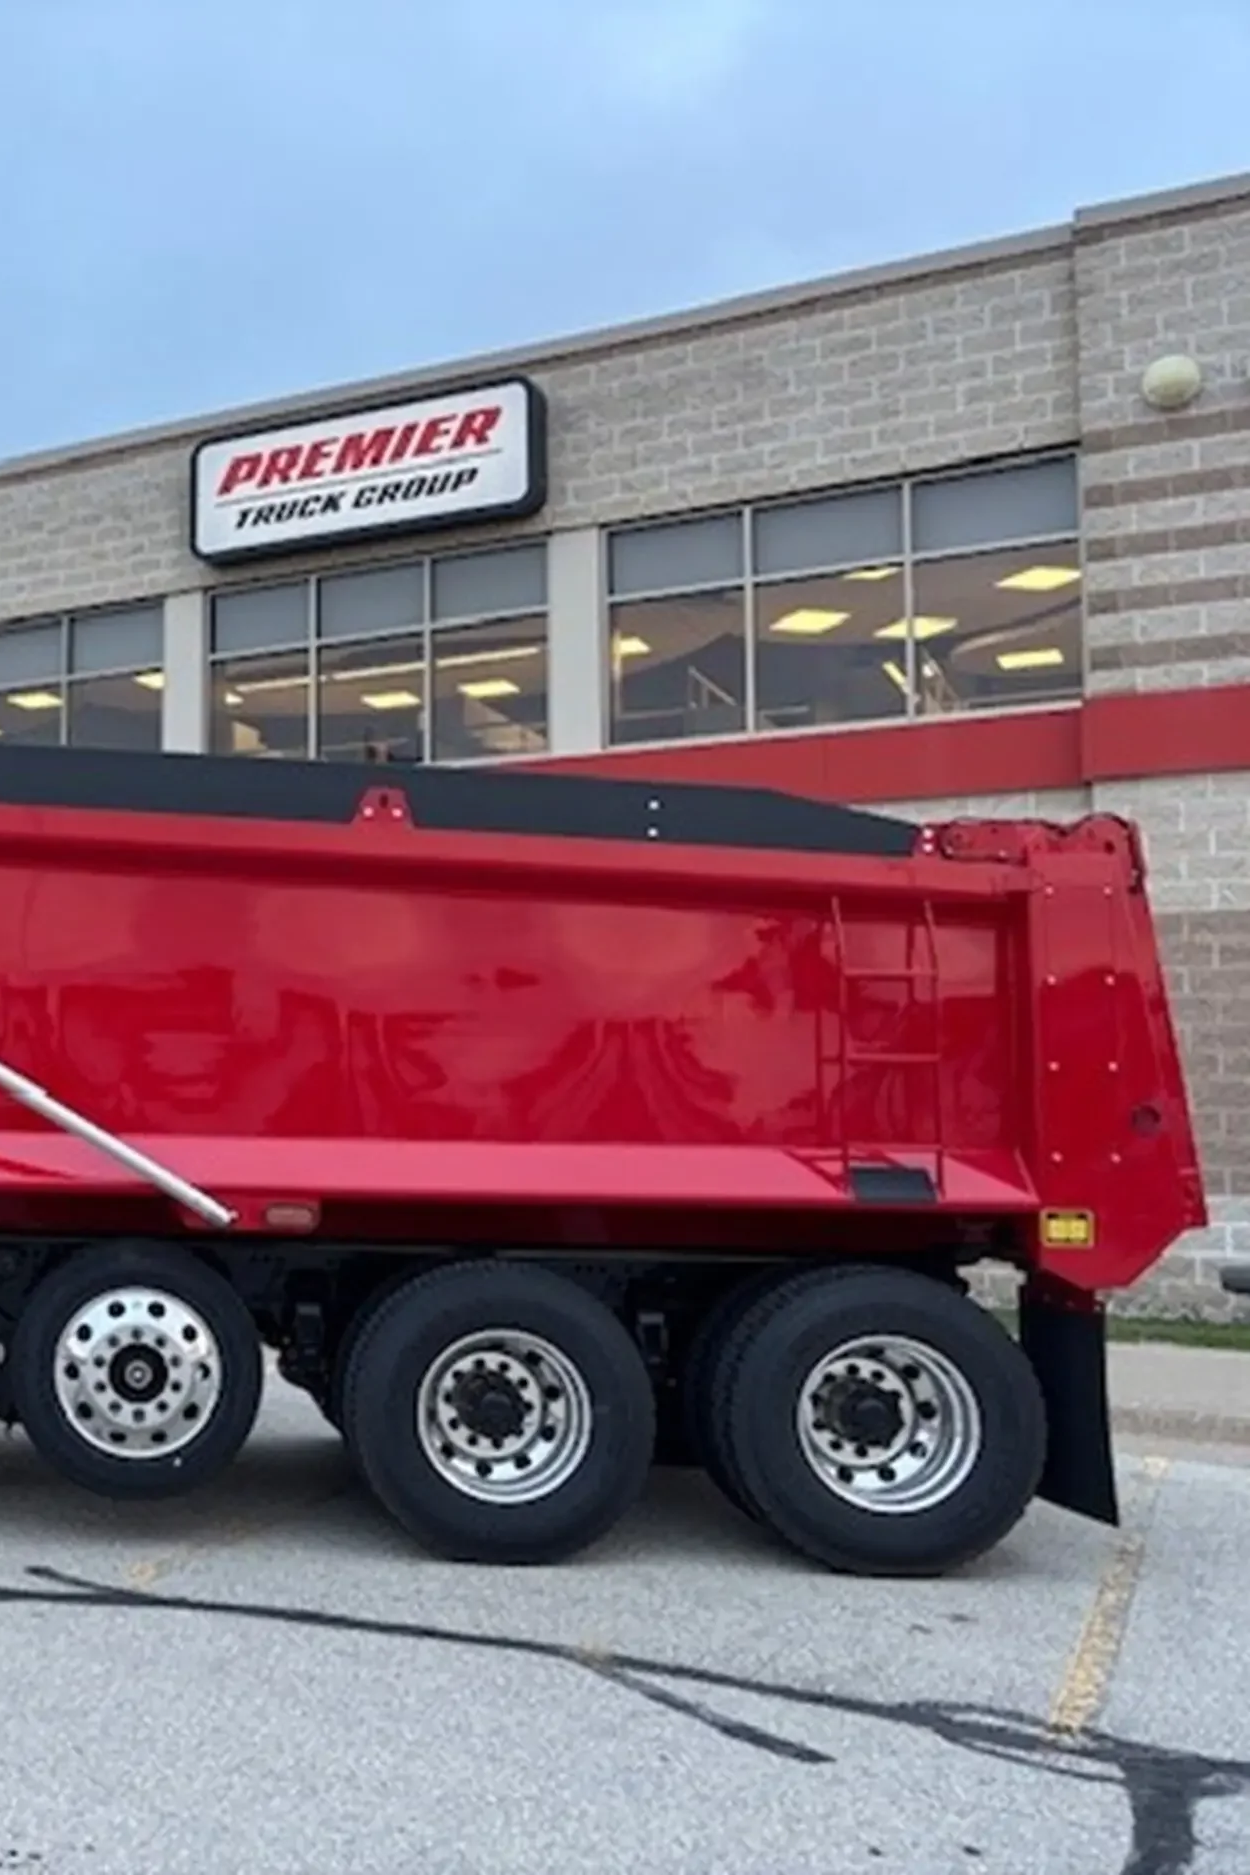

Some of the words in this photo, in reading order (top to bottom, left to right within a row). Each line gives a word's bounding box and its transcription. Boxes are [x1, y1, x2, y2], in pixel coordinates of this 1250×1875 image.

[216, 406, 503, 497] PREMIER
[235, 491, 346, 531] TRUCK
[352, 467, 479, 511] GROUP
